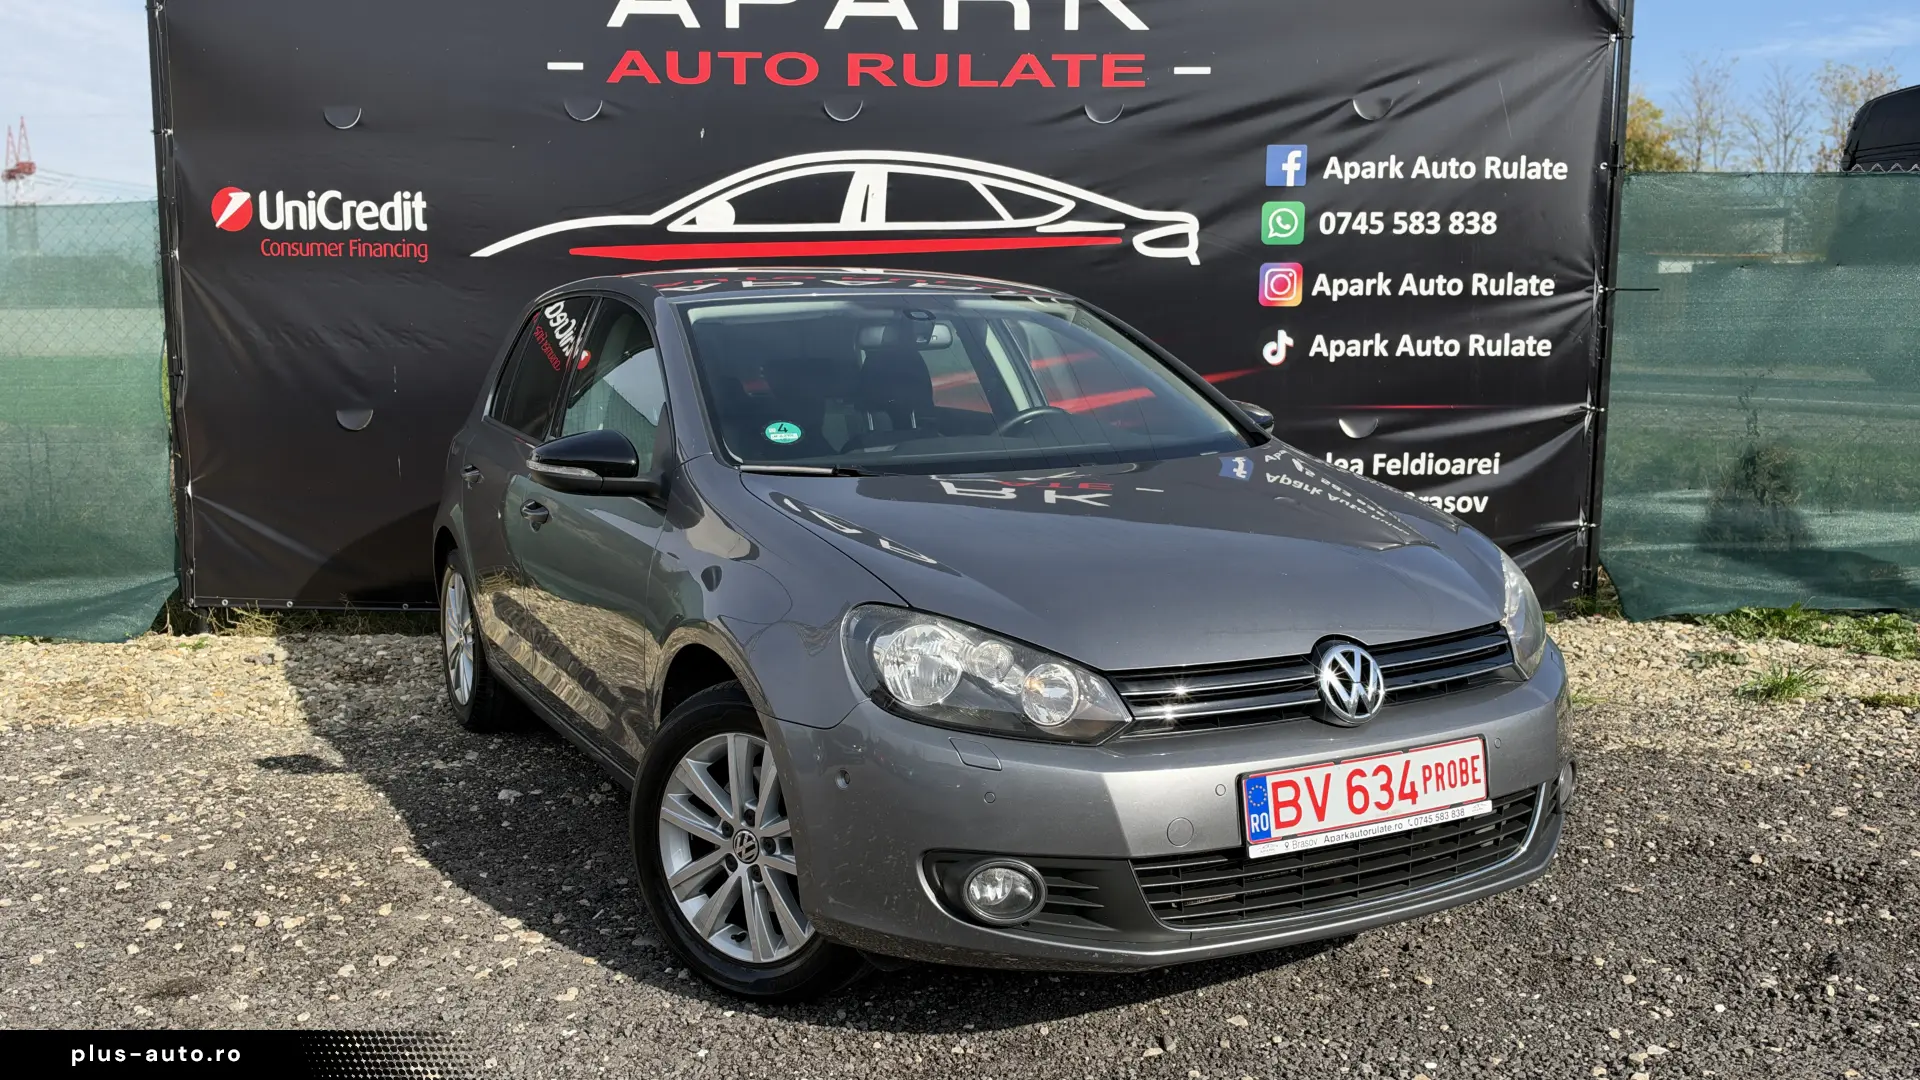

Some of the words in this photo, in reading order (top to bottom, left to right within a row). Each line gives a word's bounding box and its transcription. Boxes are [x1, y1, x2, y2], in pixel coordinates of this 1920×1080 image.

[606, 50, 819, 86] AUTO
[846, 53, 1147, 88] RULATE
[1322, 155, 1404, 185] Apark
[1410, 156, 1477, 180] Auto
[1484, 155, 1568, 180] Rulate
[259, 190, 428, 231] UniCredit
[1319, 211, 1384, 235] 0745
[1392, 211, 1441, 235] 583
[1448, 211, 1497, 235] 838
[260, 238, 345, 257] Consumer
[349, 238, 429, 263] Financing
[1311, 272, 1392, 302] Apark
[1398, 273, 1463, 297] Auto
[1471, 272, 1555, 297] Rulate
[1308, 333, 1389, 363] Apark
[1395, 334, 1461, 357] Auto
[1468, 333, 1552, 357] Rulate
[777, 423, 788, 433] 4
[1326, 452, 1364, 475] lea
[1372, 452, 1501, 475] Feldioarei
[1404, 491, 1489, 514] asov
[1271, 773, 1332, 829] BV
[1346, 760, 1419, 815] 634
[1422, 754, 1482, 794] PROBE
[1250, 812, 1269, 834] RO
[1323, 821, 1403, 844] Aparkautorulate.ro
[1414, 815, 1433, 827] 0745
[1435, 811, 1449, 822] 583
[1451, 808, 1465, 819] 838
